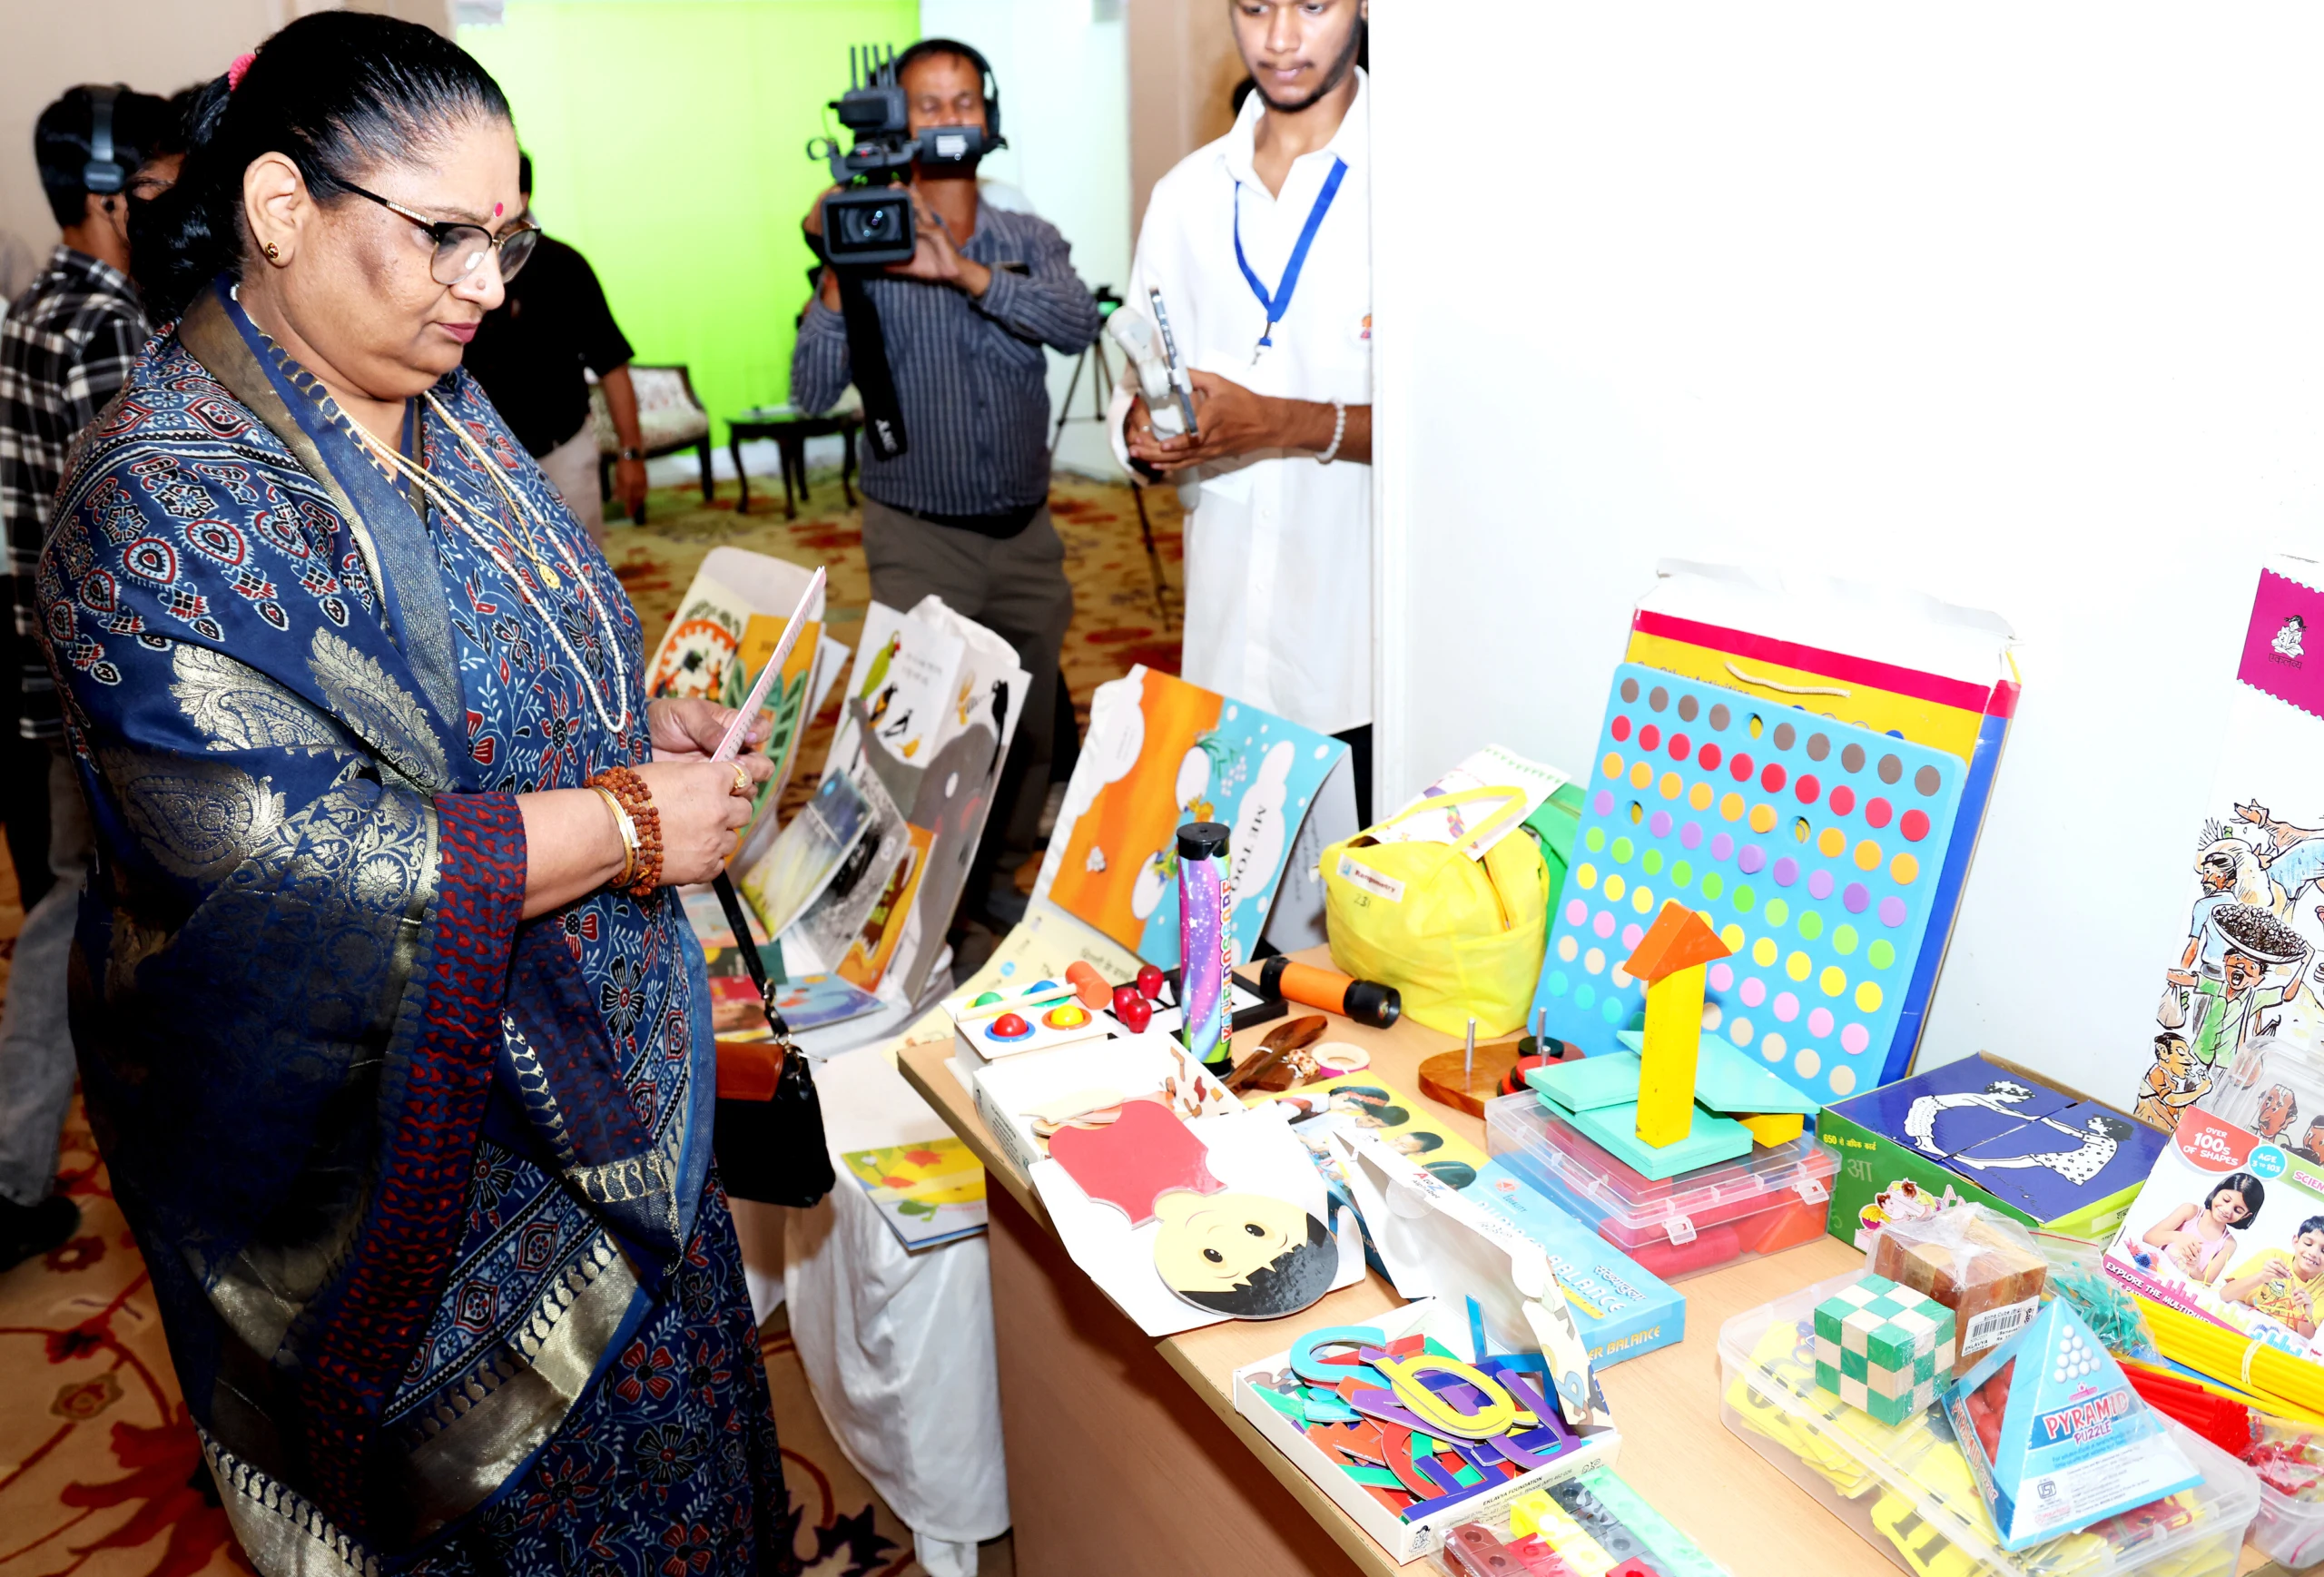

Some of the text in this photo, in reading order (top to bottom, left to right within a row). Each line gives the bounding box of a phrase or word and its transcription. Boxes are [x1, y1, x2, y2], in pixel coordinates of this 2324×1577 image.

[2269, 653, 2302, 670] एकलव्य
[1823, 1134, 1837, 1144] 650
[2206, 1127, 2228, 1138] OVER
[2182, 1145, 2239, 1166] OF SHAPES
[2258, 1153, 2277, 1163] AGE
[2105, 1262, 2144, 1289] EXPLORE
[2145, 1285, 2162, 1299] THE
[1607, 1325, 1660, 1355] BALANCE
[2043, 1391, 2129, 1440] PYRAMID
[1952, 1396, 1982, 1469] PYRAMID
[2073, 1421, 2112, 1445] PUZZLE
[1482, 1476, 1543, 1506] EKLAVYA FOUNDATION
